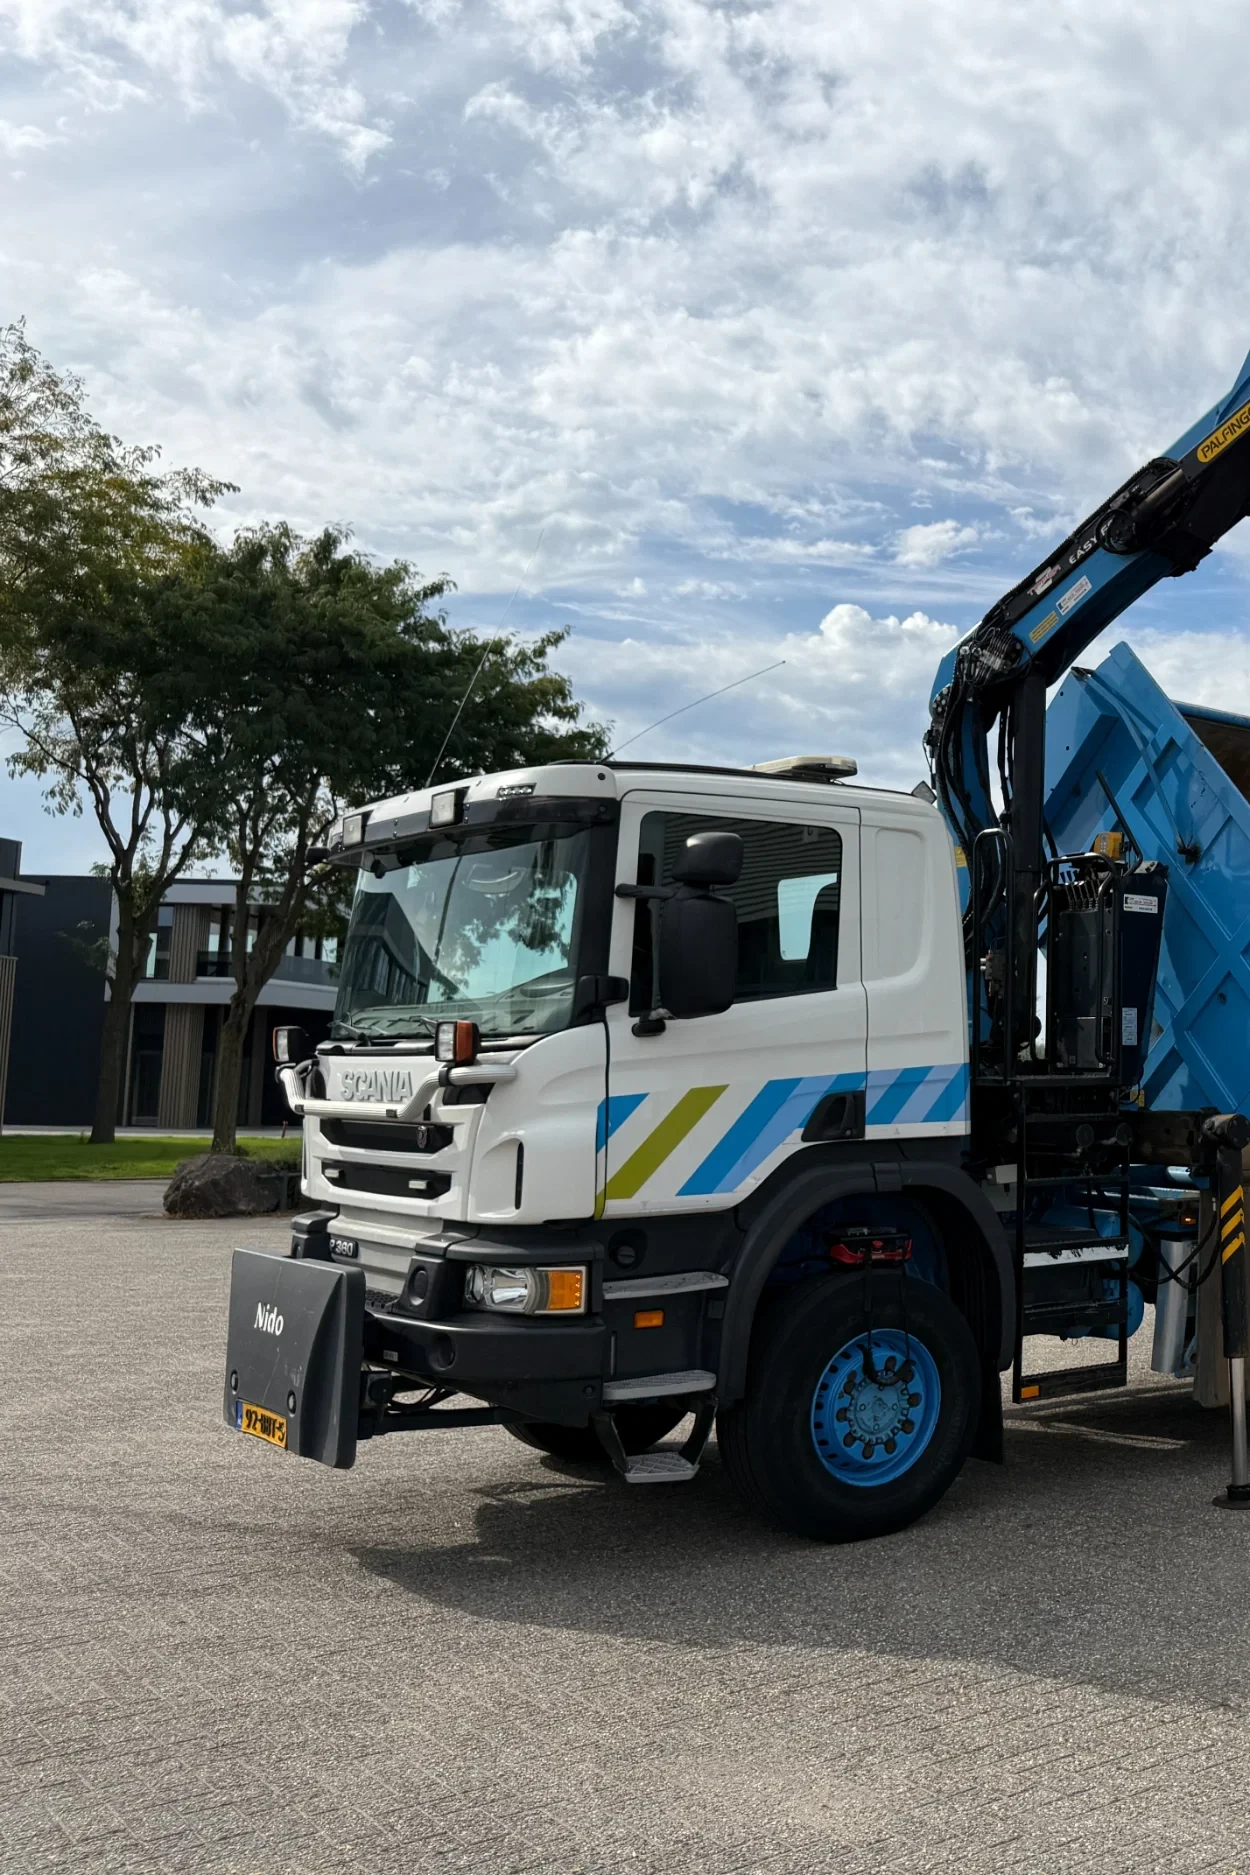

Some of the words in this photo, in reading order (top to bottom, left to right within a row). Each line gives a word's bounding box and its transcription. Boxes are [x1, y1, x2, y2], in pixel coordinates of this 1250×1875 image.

[1069, 535, 1098, 565] EASY
[341, 1069, 414, 1102] SCANIA
[254, 1302, 284, 1336] Nido
